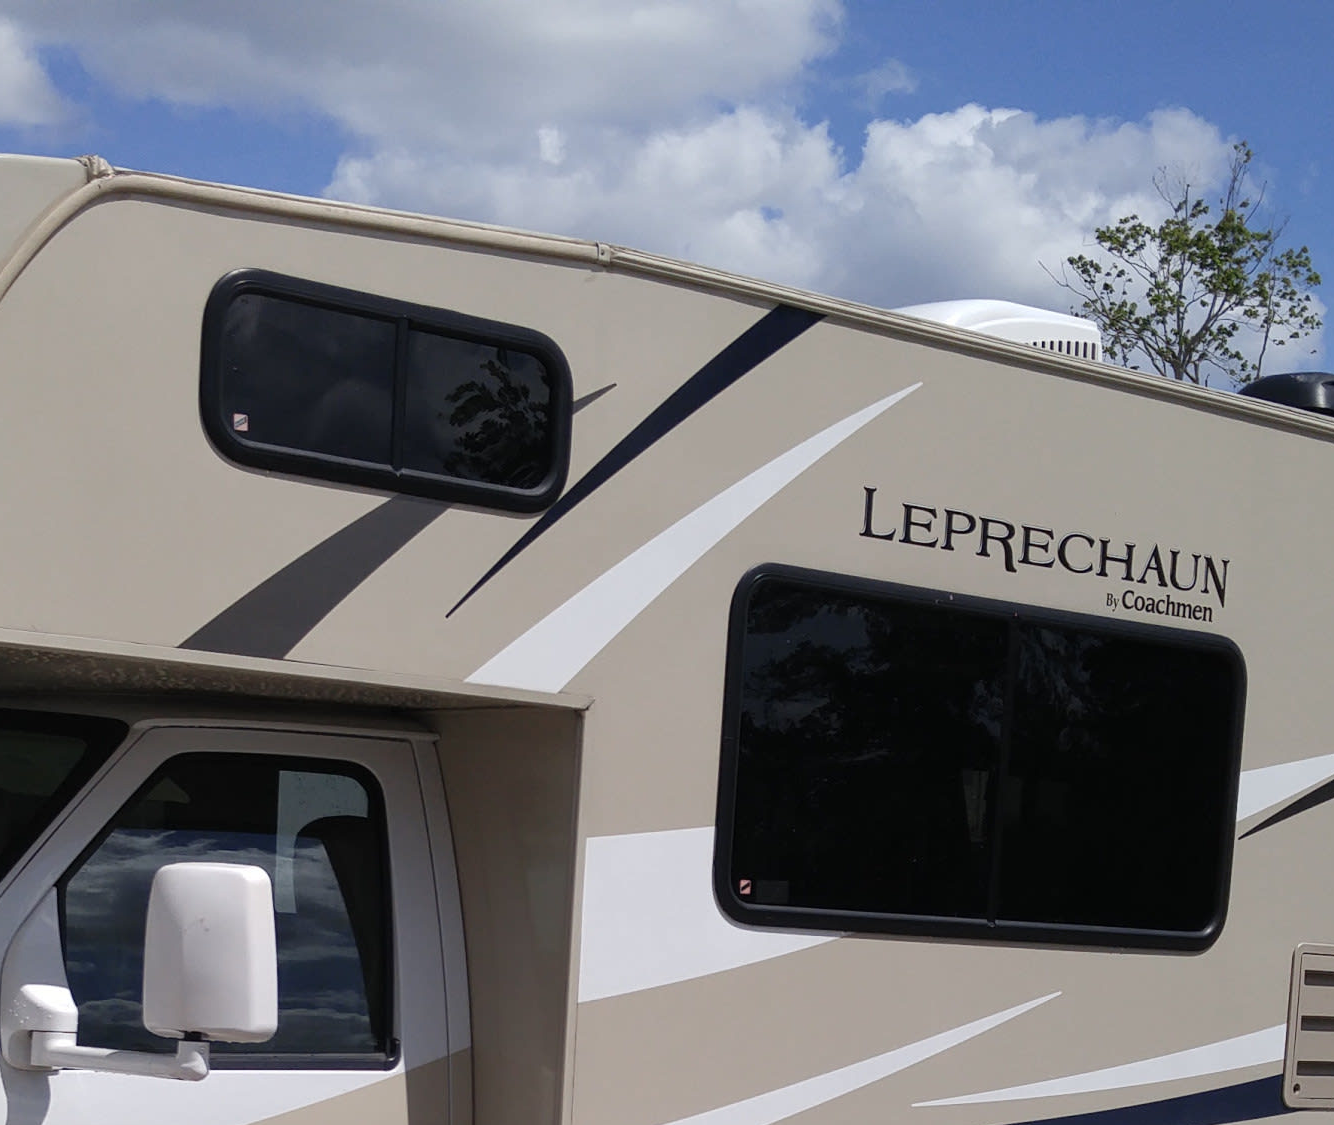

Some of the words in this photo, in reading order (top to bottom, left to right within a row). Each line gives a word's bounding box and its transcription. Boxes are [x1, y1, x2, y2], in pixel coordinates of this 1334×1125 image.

[858, 484, 1230, 609] LEPRECHAUN
[1106, 592, 1120, 612] By
[1121, 590, 1214, 623] Coachmen
